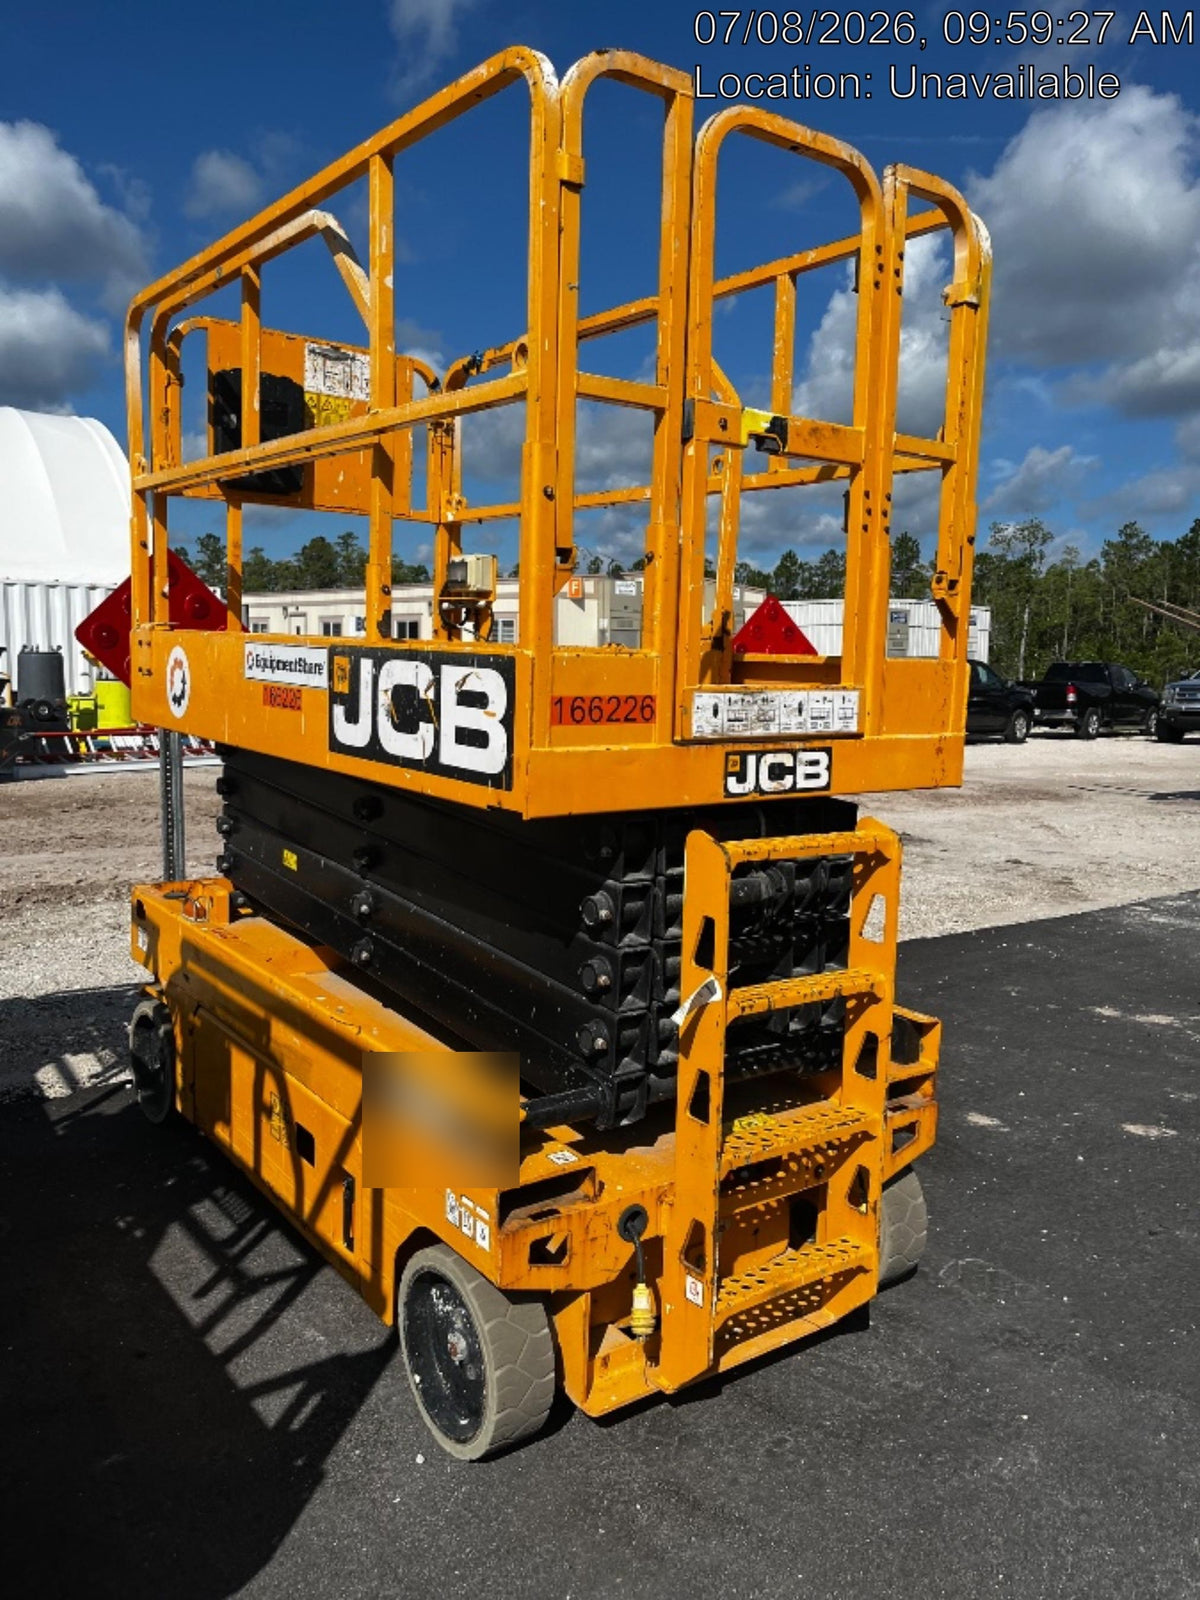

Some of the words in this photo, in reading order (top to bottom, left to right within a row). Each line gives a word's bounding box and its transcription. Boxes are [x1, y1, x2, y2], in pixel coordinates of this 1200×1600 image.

[332, 657, 508, 775] JCB
[553, 695, 655, 724] 166226
[726, 751, 829, 793] JCB
